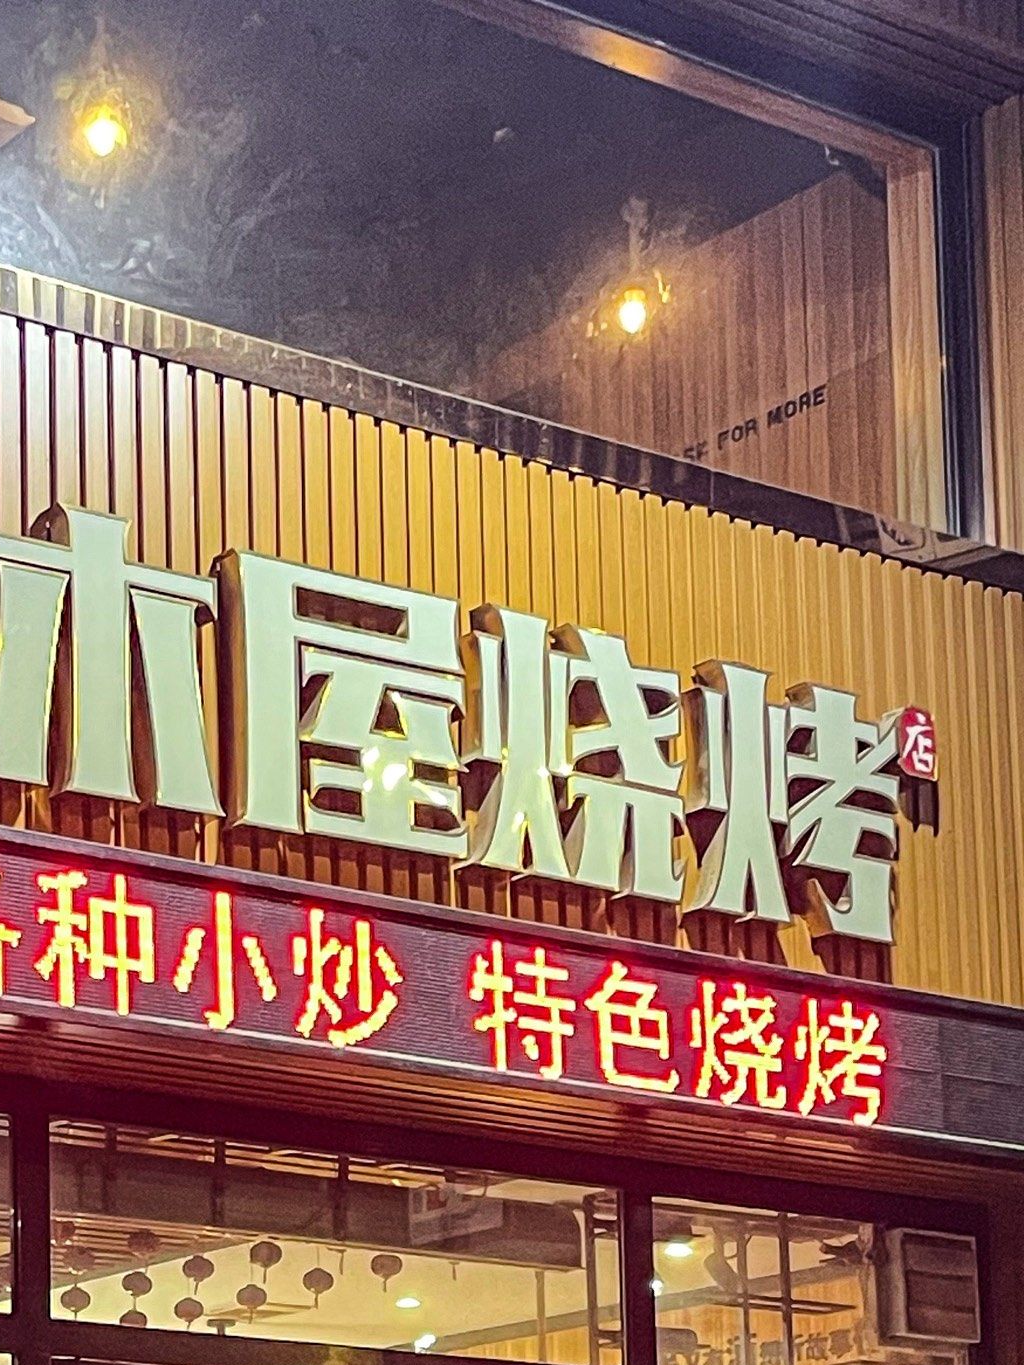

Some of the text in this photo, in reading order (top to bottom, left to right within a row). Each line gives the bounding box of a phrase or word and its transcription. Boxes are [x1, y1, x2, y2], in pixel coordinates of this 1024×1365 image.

[718, 383, 827, 450] FOR MORE
[902, 712, 933, 773] 店
[470, 936, 889, 1128] 特色烧烤
